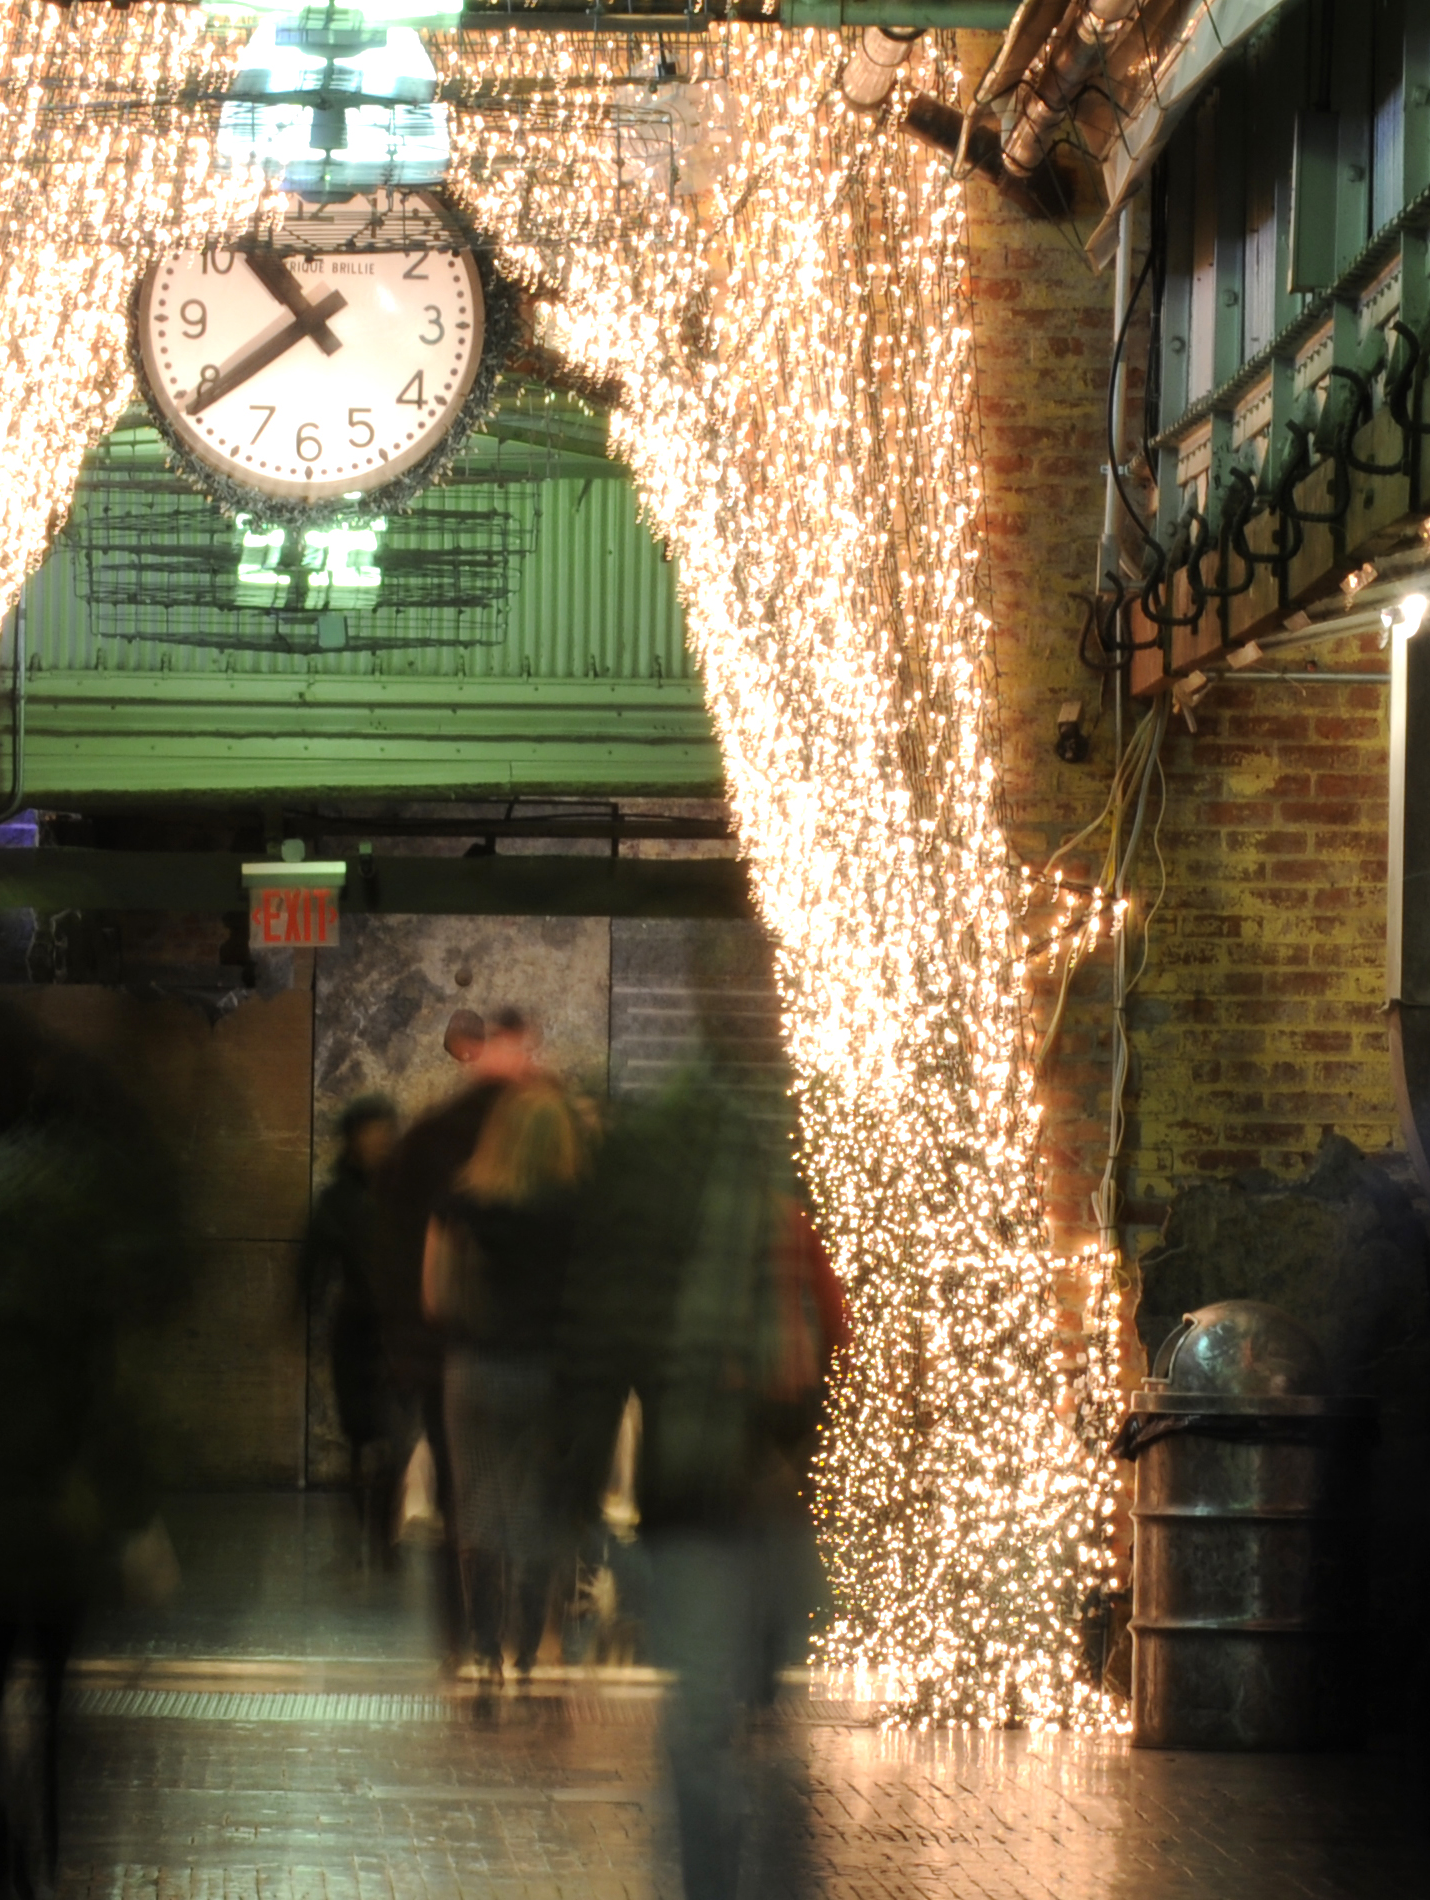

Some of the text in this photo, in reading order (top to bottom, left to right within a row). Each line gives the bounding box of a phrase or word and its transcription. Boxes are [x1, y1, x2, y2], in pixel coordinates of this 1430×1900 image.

[332, 261, 375, 275] BRILLIE
[403, 241, 430, 280] 2
[180, 298, 208, 340] 9
[419, 304, 446, 346] 3
[196, 363, 222, 402] 8
[396, 369, 428, 411] 4
[249, 405, 277, 446] 7
[295, 422, 323, 463] 6
[348, 408, 375, 448] 5
[263, 888, 331, 942] EXIT
